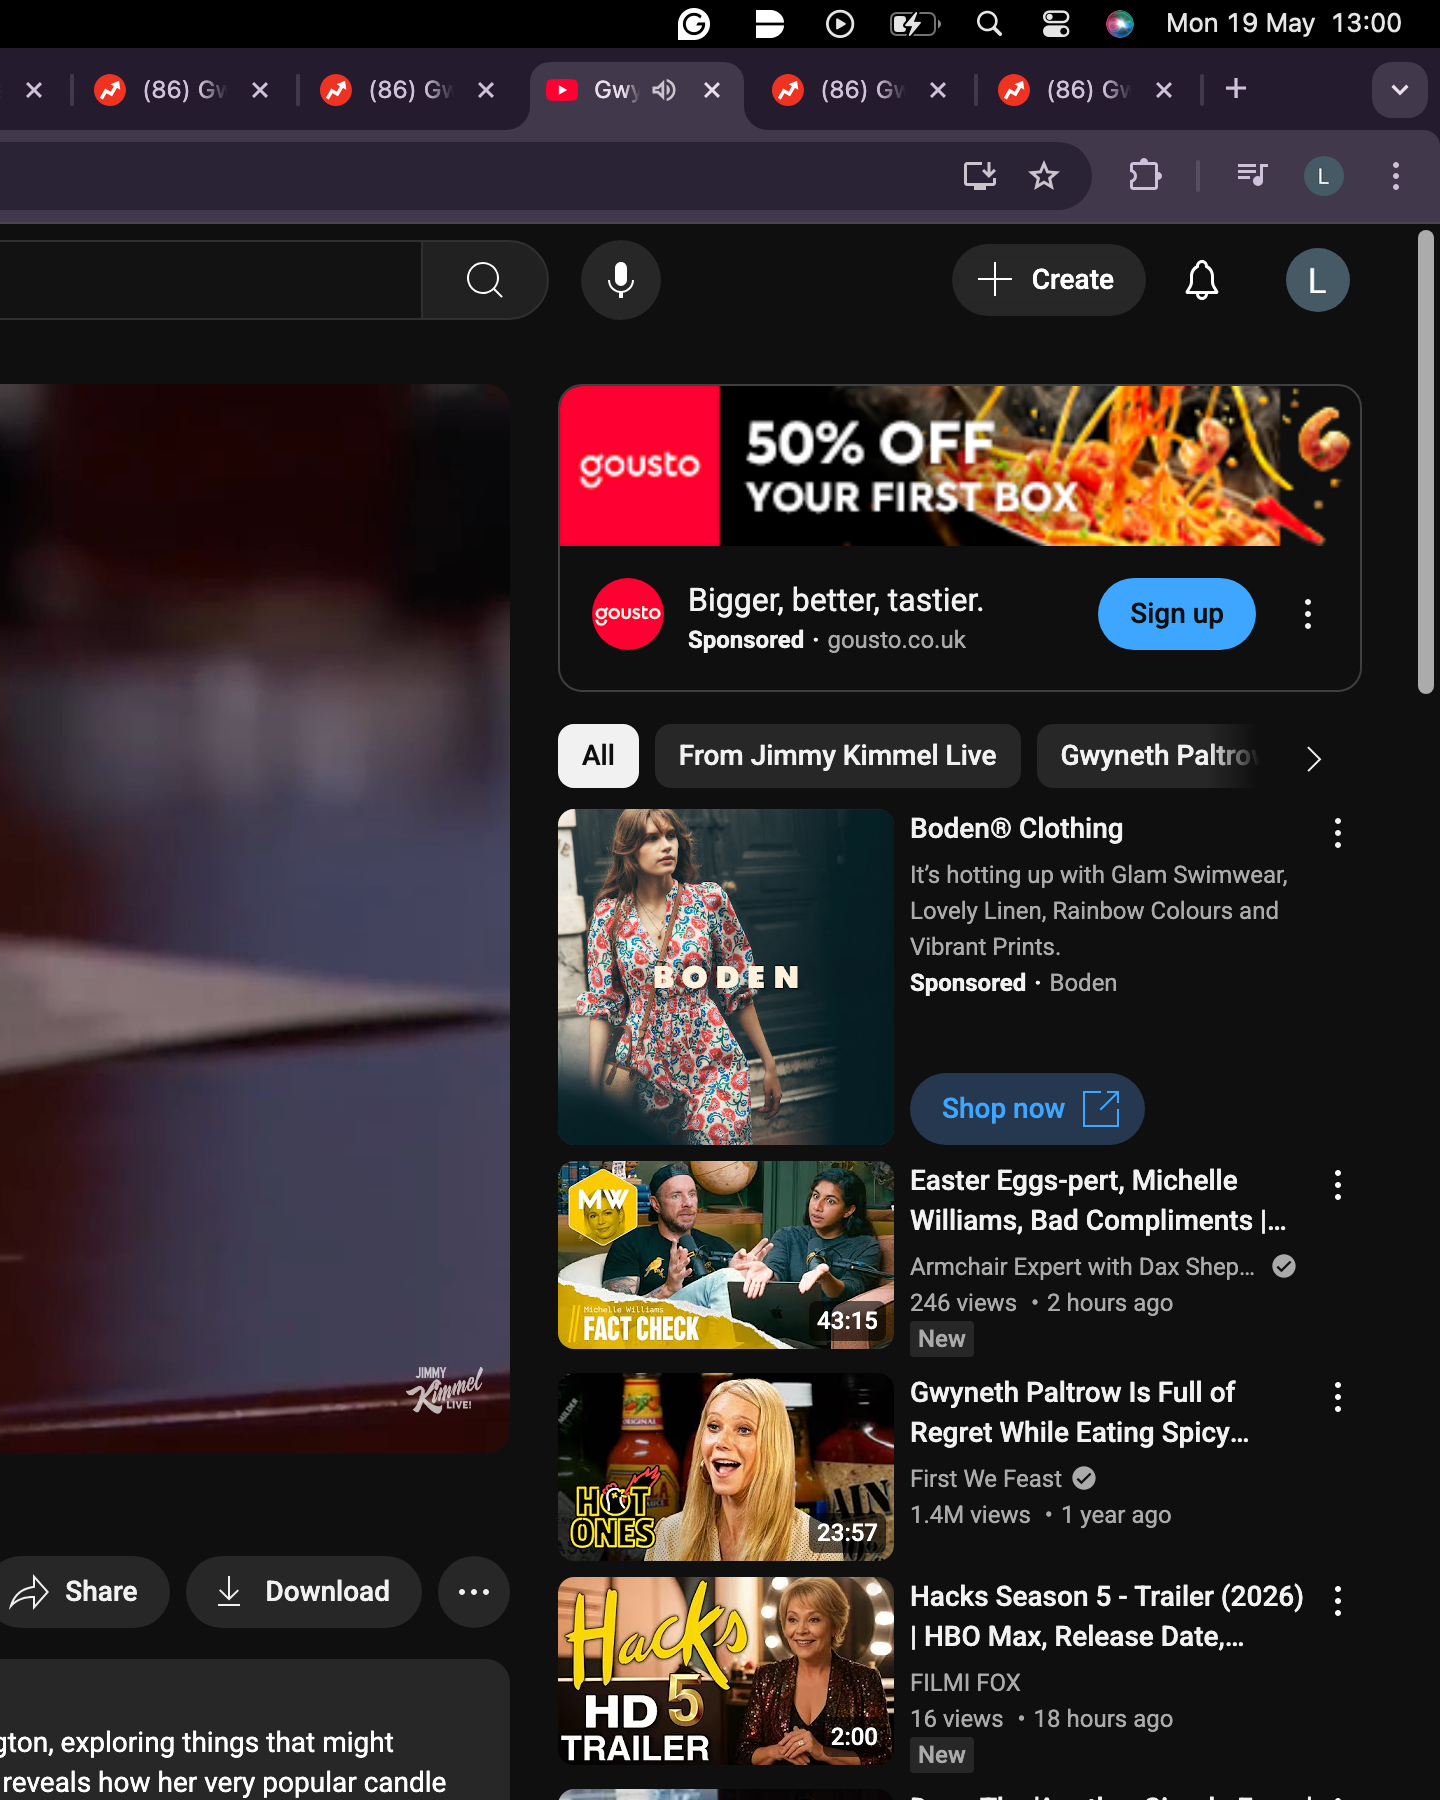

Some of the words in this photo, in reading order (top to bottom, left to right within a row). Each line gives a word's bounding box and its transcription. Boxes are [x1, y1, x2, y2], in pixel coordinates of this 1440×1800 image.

[1167, 12, 1218, 33] Mon
[1228, 11, 1258, 34] 19
[1266, 12, 1316, 38] May
[1332, 11, 1402, 34] 13:00
[1032, 267, 1115, 291] Create
[1309, 267, 1327, 294] L
[747, 421, 865, 465] 50%
[880, 421, 995, 465] OFF
[578, 451, 702, 490] gousto
[745, 482, 860, 513] YOUR
[872, 482, 984, 513] FIRST
[994, 482, 1078, 513] BOX
[595, 605, 661, 626] gousto
[689, 586, 784, 619] Bigger,
[792, 585, 880, 617] better,
[886, 586, 984, 613] tastier.
[1130, 601, 1186, 630] Sign
[1193, 606, 1224, 630] up
[687, 628, 804, 654] Sponsored
[827, 628, 967, 654] gousto.co.uk
[581, 742, 614, 766] All
[679, 743, 743, 767] From
[750, 743, 837, 772] Jimmy
[843, 742, 938, 767] Kimmel
[946, 743, 997, 767] Live
[1060, 742, 1169, 772] Gwyneth
[910, 815, 1012, 840] Boden®
[1019, 815, 1123, 845] Clothing
[909, 935, 987, 956] Vibrant
[993, 936, 1061, 956] Prints.
[654, 965, 799, 989] BODEN
[909, 971, 1026, 997] Sponsored
[1050, 971, 1117, 992] Boden
[942, 1095, 1007, 1125] Shop
[1013, 1101, 1066, 1119] now
[910, 1168, 991, 1192] Easter
[997, 1168, 1125, 1197] Eggs-pert,
[1132, 1167, 1238, 1192] Michelle
[578, 1188, 630, 1210] MW
[909, 1255, 1009, 1276] Armchair
[1014, 1256, 1082, 1281] Expert
[1087, 1255, 1133, 1276] with
[1139, 1256, 1180, 1276] Dax
[910, 1292, 951, 1312] 246
[956, 1292, 1017, 1312] views
[1047, 1292, 1061, 1312] 2
[1067, 1291, 1127, 1312] hours
[1133, 1297, 1174, 1317] ago
[584, 1315, 632, 1341] FACT
[637, 1315, 699, 1341] CHECK
[816, 1310, 878, 1330] 43:15
[910, 1379, 1019, 1409] Gwyneth
[1026, 1379, 1122, 1404] Paltrow
[1129, 1380, 1151, 1404] Is
[1158, 1379, 1202, 1404] Full
[1209, 1379, 1237, 1404] of
[911, 1468, 958, 1488] First
[963, 1468, 998, 1488] We
[1004, 1468, 1063, 1488] Feast
[576, 1485, 651, 1517] HOT
[570, 1517, 656, 1549] ONES
[817, 1522, 878, 1542] 23:57
[65, 1578, 138, 1603] Share
[266, 1578, 390, 1603] Download
[910, 1583, 989, 1608] Hacks
[995, 1584, 1088, 1608] Season
[1096, 1584, 1112, 1608] 5
[1133, 1583, 1215, 1608] Trailer
[1221, 1582, 1304, 1614] (2026)
[565, 1580, 748, 1690] Hacks
[911, 1672, 970, 1692] FILMI
[977, 1672, 1021, 1692] FOX
[585, 1694, 658, 1729] HD
[668, 1673, 705, 1727] 5
[561, 1734, 710, 1761] TRAILER
[831, 1726, 878, 1746] 2:00
[918, 1744, 967, 1764] New
